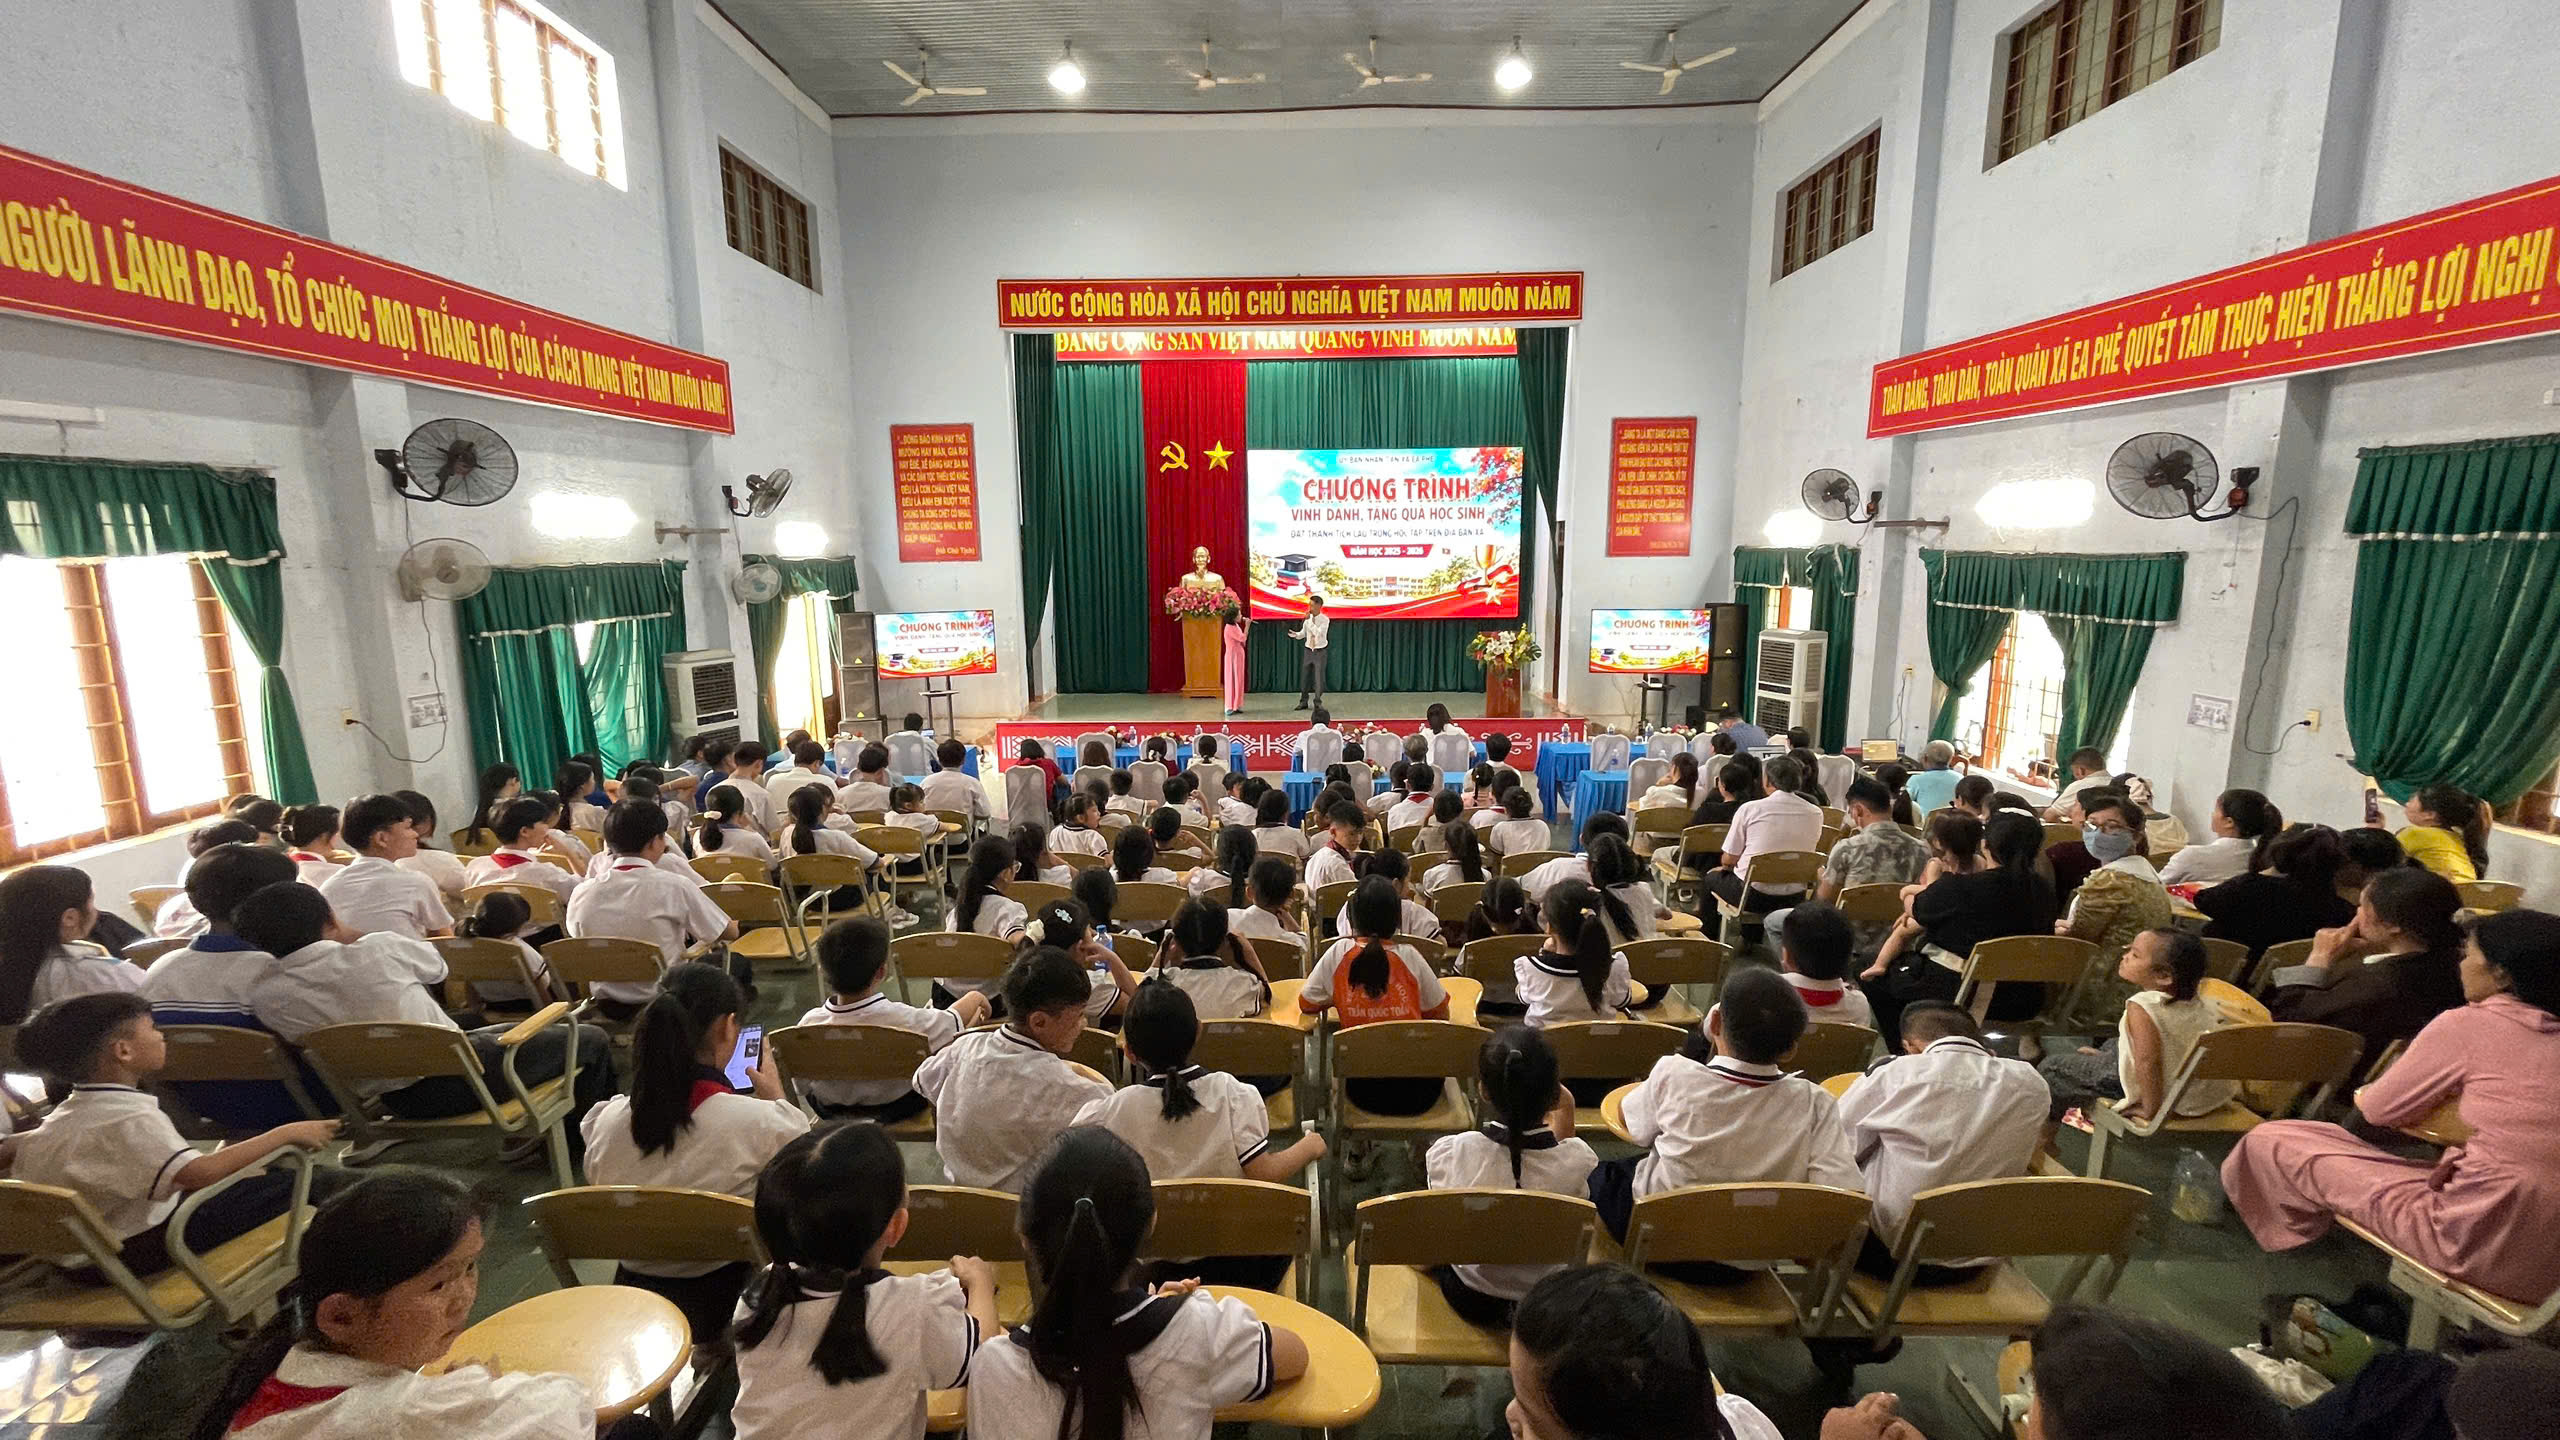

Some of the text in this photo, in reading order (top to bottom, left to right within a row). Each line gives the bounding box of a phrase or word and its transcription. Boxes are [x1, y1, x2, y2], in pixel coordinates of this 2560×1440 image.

[103, 218, 196, 305] LÃNH
[195, 249, 268, 328] ĐẠO,
[265, 251, 303, 328] TỔ
[306, 275, 371, 342] CHỨC
[372, 295, 417, 361] MỌI
[416, 296, 481, 365] THẮNG
[480, 323, 510, 380] LỢI
[510, 320, 544, 379] CỦA
[543, 334, 582, 387] CÁCH
[581, 350, 621, 399] MẠNG
[620, 355, 645, 406] VIỆT
[647, 366, 671, 404] NAM
[671, 369, 702, 411] MUÔN
[1010, 280, 1571, 322] NƯỚC CỘNG HÒA XÃ HỘI CHỦ NGHĨA VIỆT NAM MUÔN NĂM
[1882, 377, 1905, 417] TOÀN
[1931, 364, 1959, 408] TOÀN
[1984, 351, 2015, 398] TOÀN
[2014, 342, 2050, 396] QUÂN
[2049, 336, 2071, 386] XÃ
[2070, 339, 2091, 382] EA
[2090, 321, 2124, 377] PHÊ
[2123, 304, 2178, 375] QUYẾT
[2177, 302, 2219, 361] TÂM
[2220, 291, 2275, 358] THỰC
[2274, 274, 2332, 349] HIỆN
[2333, 247, 2418, 330] THẮNG
[2417, 243, 2470, 323] LỢI
[2469, 226, 2554, 306] NGHỊ
[1299, 330, 1365, 354] QUANG
[1370, 329, 1415, 348] VINH
[1303, 473, 1471, 501] CHƯƠNG TRÌNH
[1291, 508, 1321, 521] VINH
[1326, 508, 1364, 522] DANH,
[1457, 506, 1485, 520] SINH
